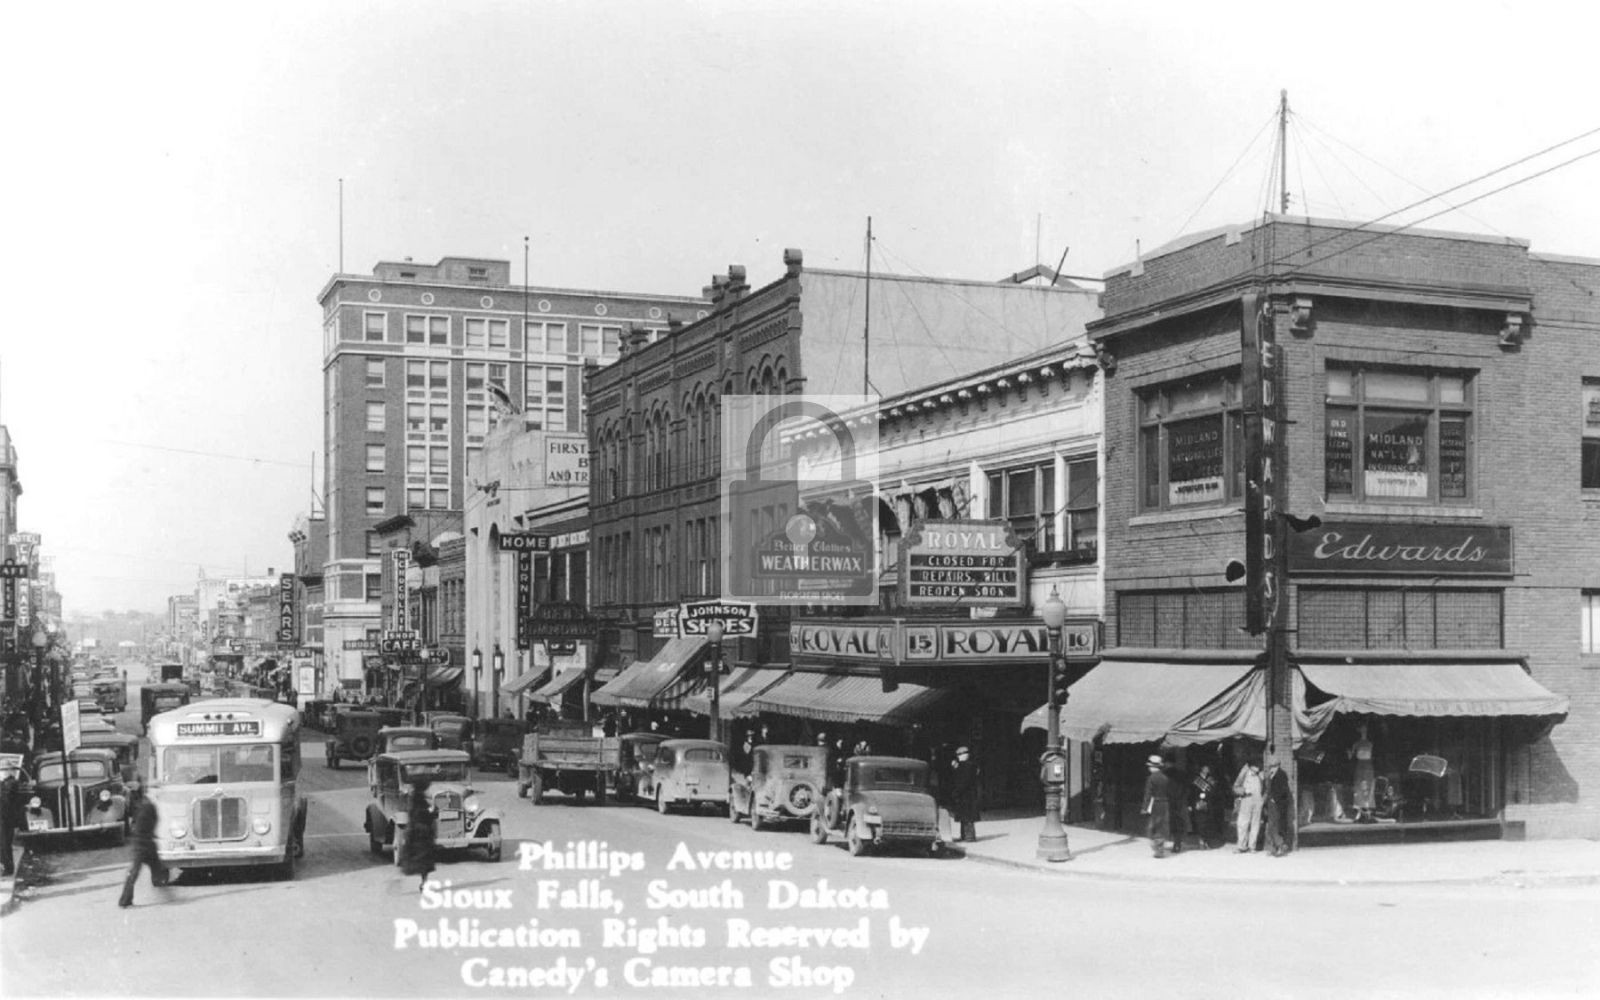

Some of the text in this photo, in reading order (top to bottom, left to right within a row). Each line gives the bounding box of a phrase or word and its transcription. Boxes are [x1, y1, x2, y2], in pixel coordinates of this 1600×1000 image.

[1369, 433, 1423, 446] MIDLAND
[550, 442, 587, 454] FIRST
[548, 470, 571, 482] AND
[1262, 340, 1275, 599] EDWARDS
[502, 536, 547, 548] HOME
[927, 531, 1002, 549] ROYAL
[1314, 531, 1487, 562] Edwards
[761, 555, 862, 572] WEATHERWAX
[928, 556, 1005, 566] CLOSED FOR
[398, 560, 406, 632] CHOCOLATE
[919, 586, 1005, 597] REOPEN SOON
[282, 578, 292, 641] SEARS
[690, 606, 747, 618] JOHNSON
[389, 632, 415, 640] SHOP
[802, 628, 877, 654] ROYAL
[909, 635, 932, 650] 15
[1069, 633, 1090, 646] 10
[383, 640, 421, 652] CAFE
[180, 724, 224, 734] SUMMIT
